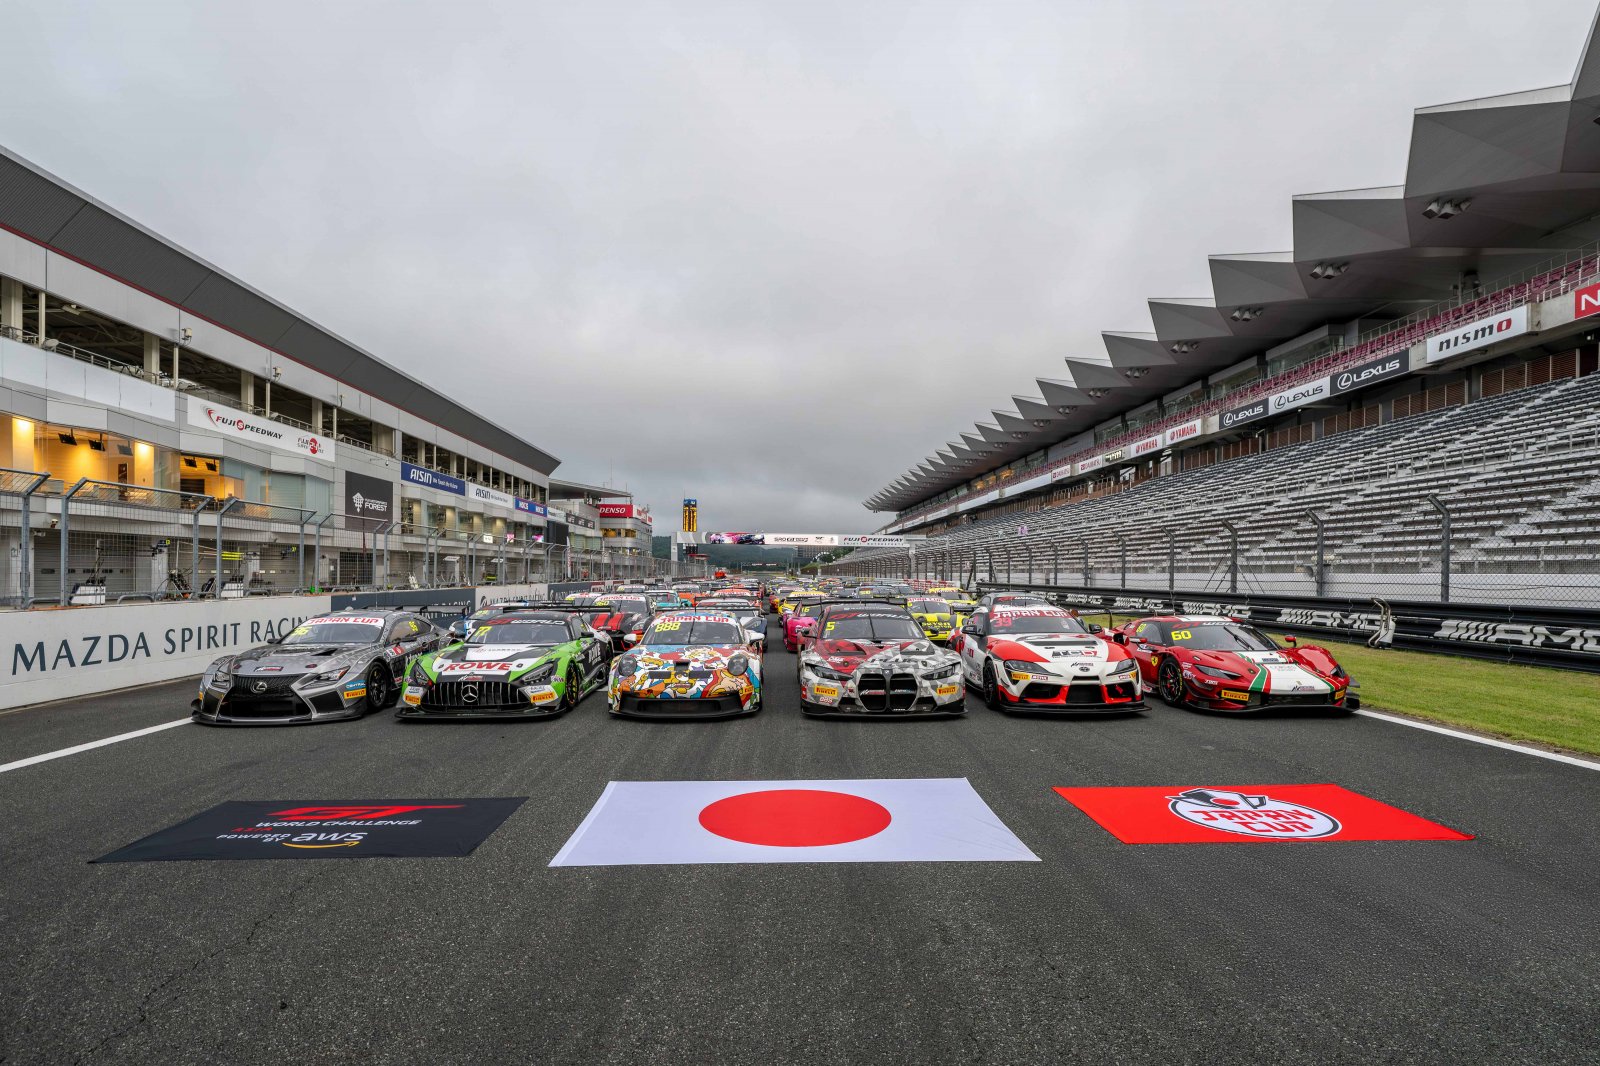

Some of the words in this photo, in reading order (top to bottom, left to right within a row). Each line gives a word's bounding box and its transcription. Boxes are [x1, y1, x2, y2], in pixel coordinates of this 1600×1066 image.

[1581, 292, 1600, 311] N
[1438, 318, 1512, 352] nismo
[1353, 359, 1400, 382] LEXUS
[1286, 385, 1323, 403] LEXUS
[1233, 405, 1264, 421] LEXUS
[216, 415, 236, 427] FUJI
[236, 419, 283, 439] SPEEDWAY
[1175, 424, 1197, 440] YAMAHA
[1140, 439, 1157, 452] YAMAHA
[410, 468, 432, 484] AISIN
[475, 488, 490, 500] AISIN
[365, 502, 388, 512] FOREST
[993, 610, 1039, 618] JAPAN
[659, 616, 702, 624] JAPAN
[654, 622, 682, 633] 888
[826, 621, 836, 631] 5
[1171, 630, 1192, 640] 60
[12, 634, 151, 677] MAZDA
[163, 622, 241, 656] SPIRIT
[250, 615, 309, 644] RACI
[443, 661, 513, 672] ROWE
[345, 690, 365, 698] PIRELLI
[816, 687, 836, 696] PIRELLI
[938, 686, 957, 695] PIRELLI
[1223, 691, 1248, 700] PIRELLI
[532, 692, 555, 701] PIRELLI
[265, 804, 467, 821] GT
[1188, 809, 1317, 822] JAPAN
[256, 820, 320, 828] WORLD
[321, 819, 422, 827] CHALLENGE
[1233, 820, 1314, 833] CUP
[291, 832, 368, 842] aws
